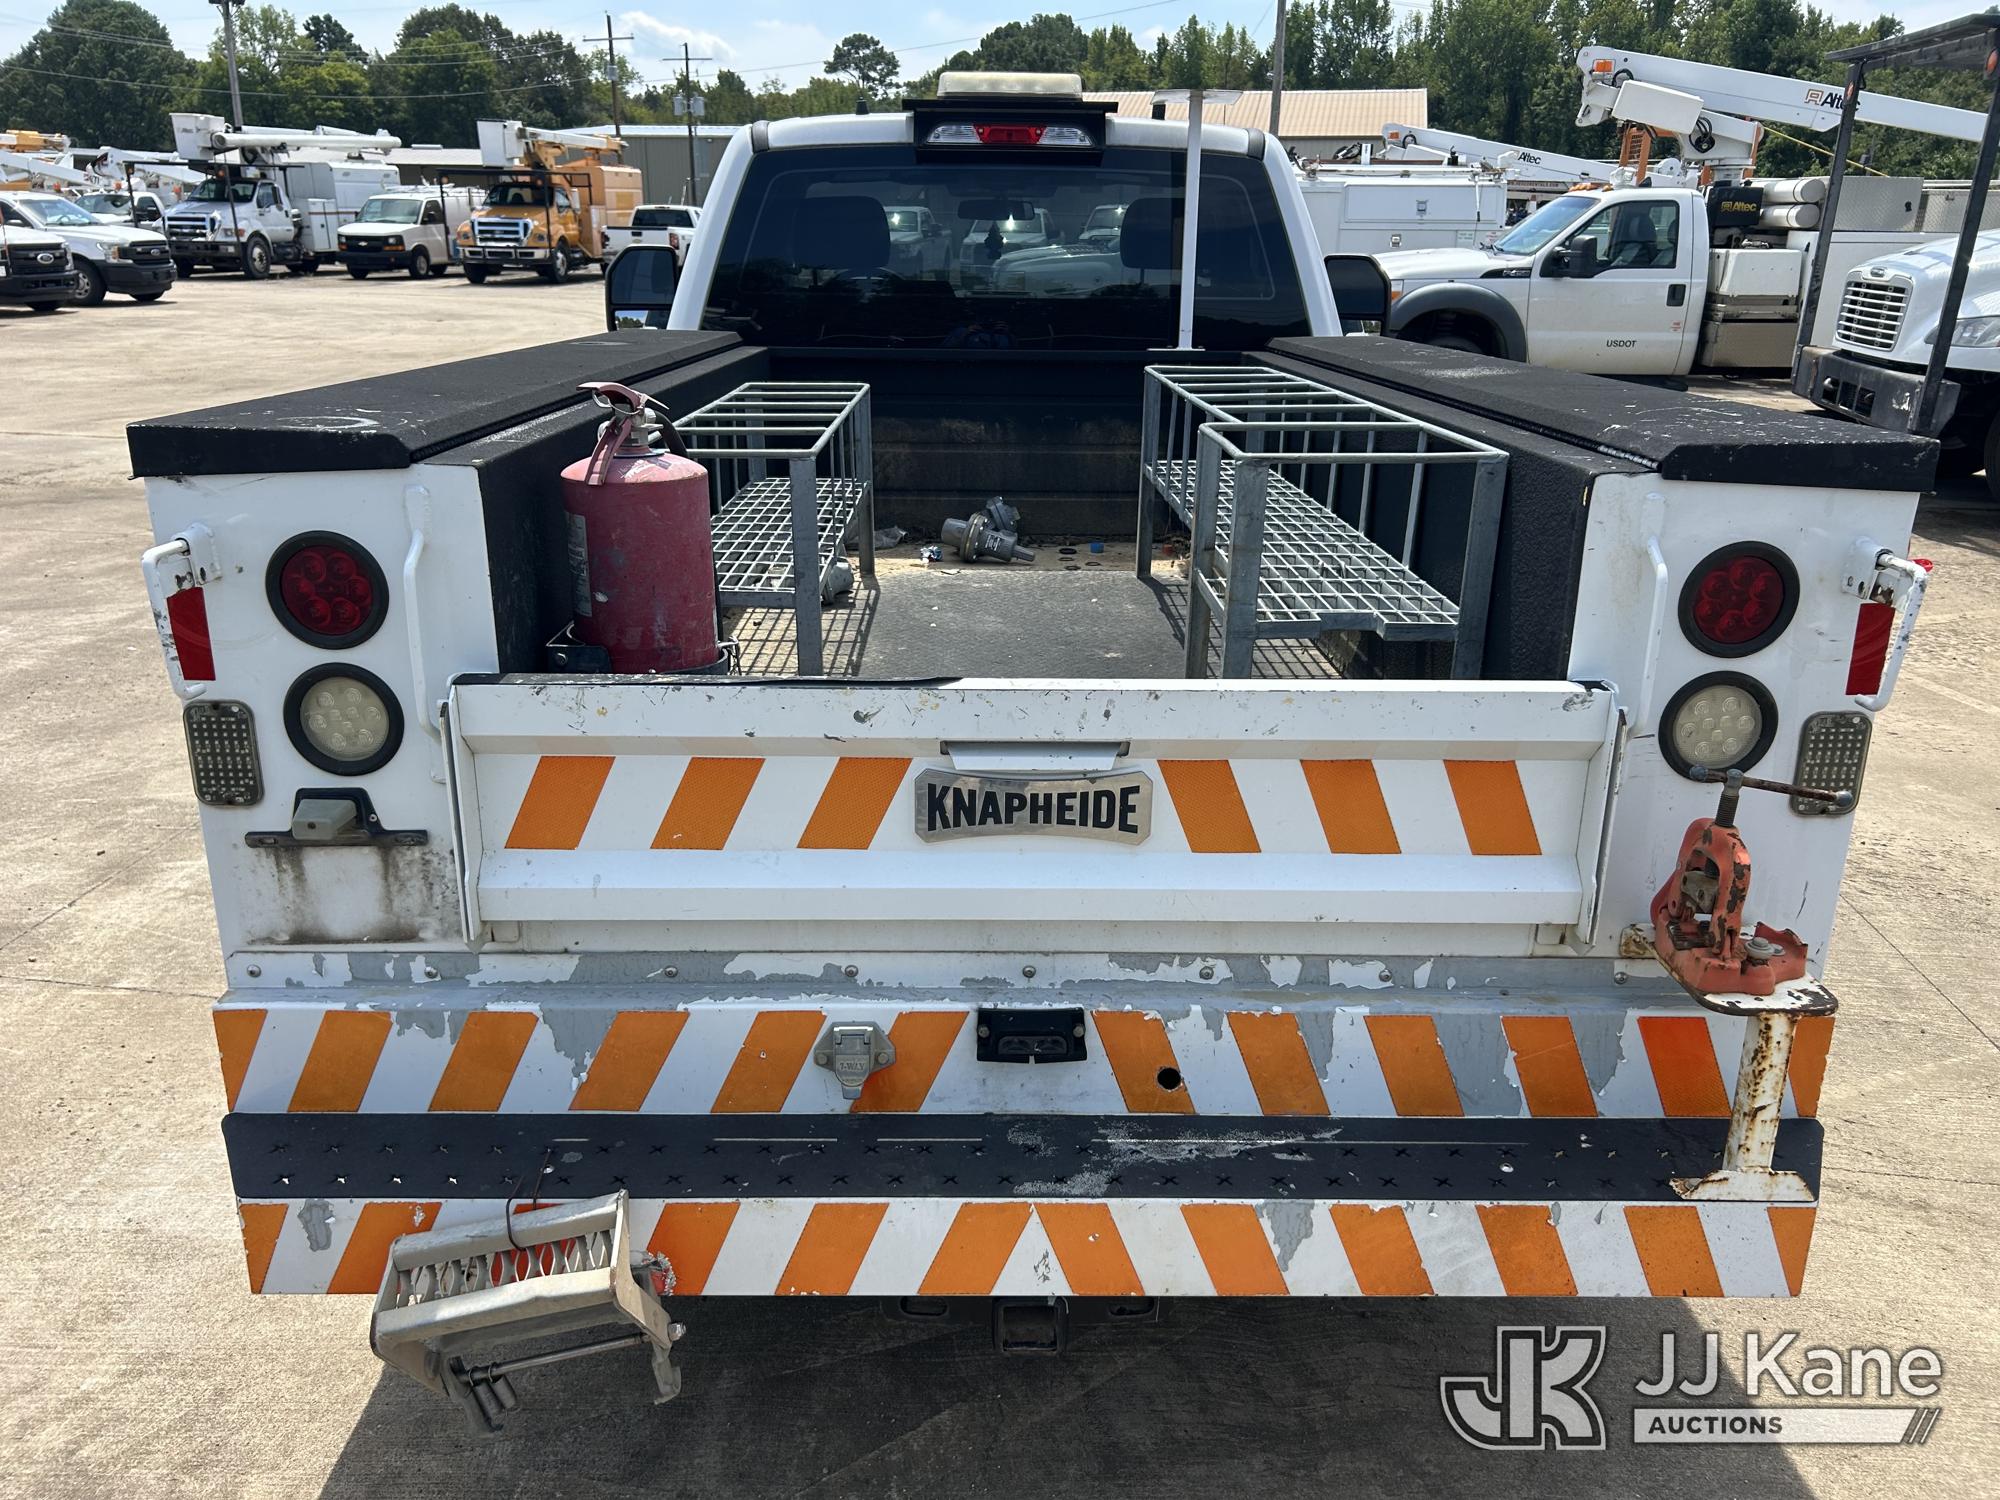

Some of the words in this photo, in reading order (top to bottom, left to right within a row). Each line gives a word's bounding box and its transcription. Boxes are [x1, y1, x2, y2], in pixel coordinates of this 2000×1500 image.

[1517, 151, 1542, 165] Altec
[1732, 201, 1757, 212] Altec
[1606, 339, 1638, 348] USDOT
[927, 783, 1140, 834] KNAPHEIDE
[839, 1062, 865, 1072] 7-WAY
